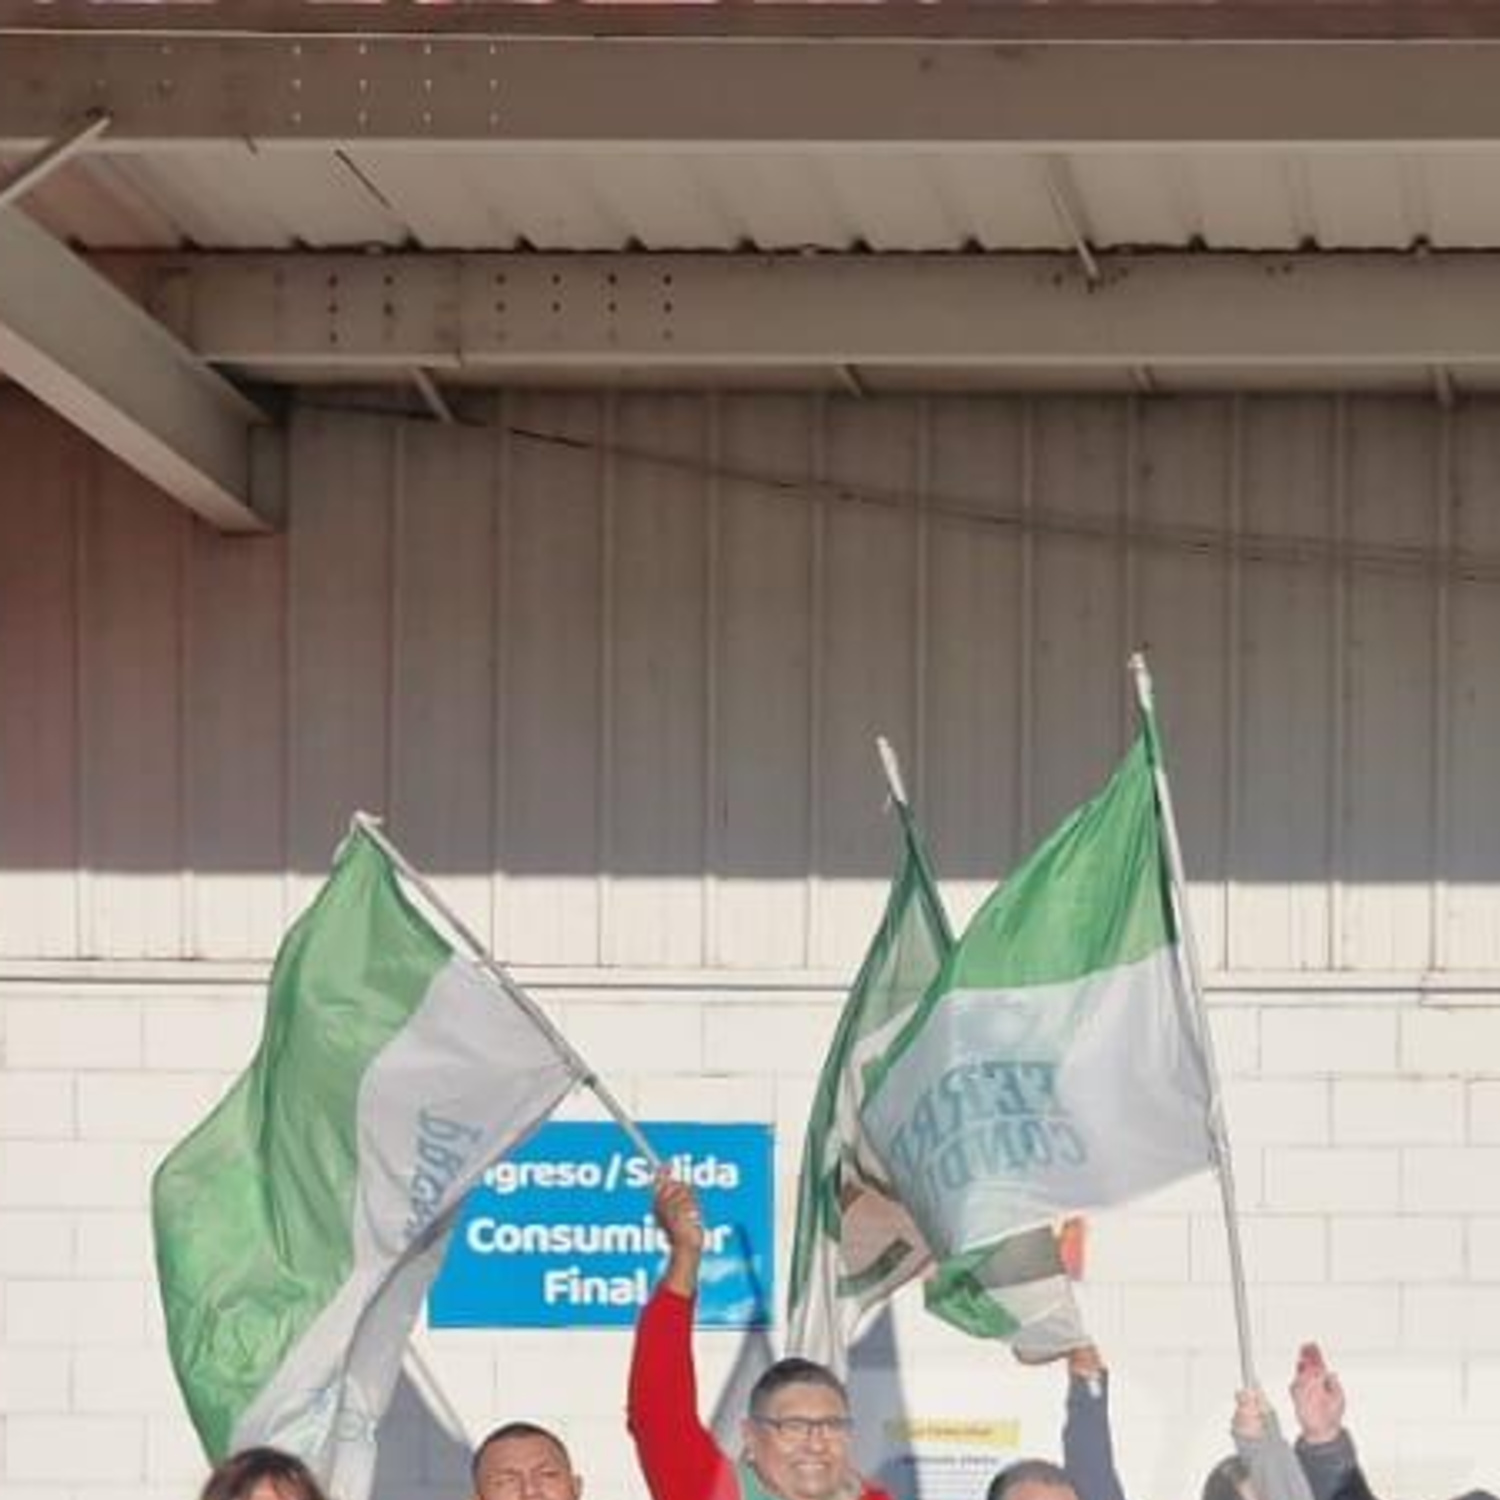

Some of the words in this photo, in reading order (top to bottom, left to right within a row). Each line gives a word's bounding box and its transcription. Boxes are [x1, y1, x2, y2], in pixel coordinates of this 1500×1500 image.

[484, 1160, 600, 1193] greso
[625, 1155, 738, 1188] Slida
[466, 1215, 732, 1253] Consumir
[543, 1267, 648, 1306] Final
